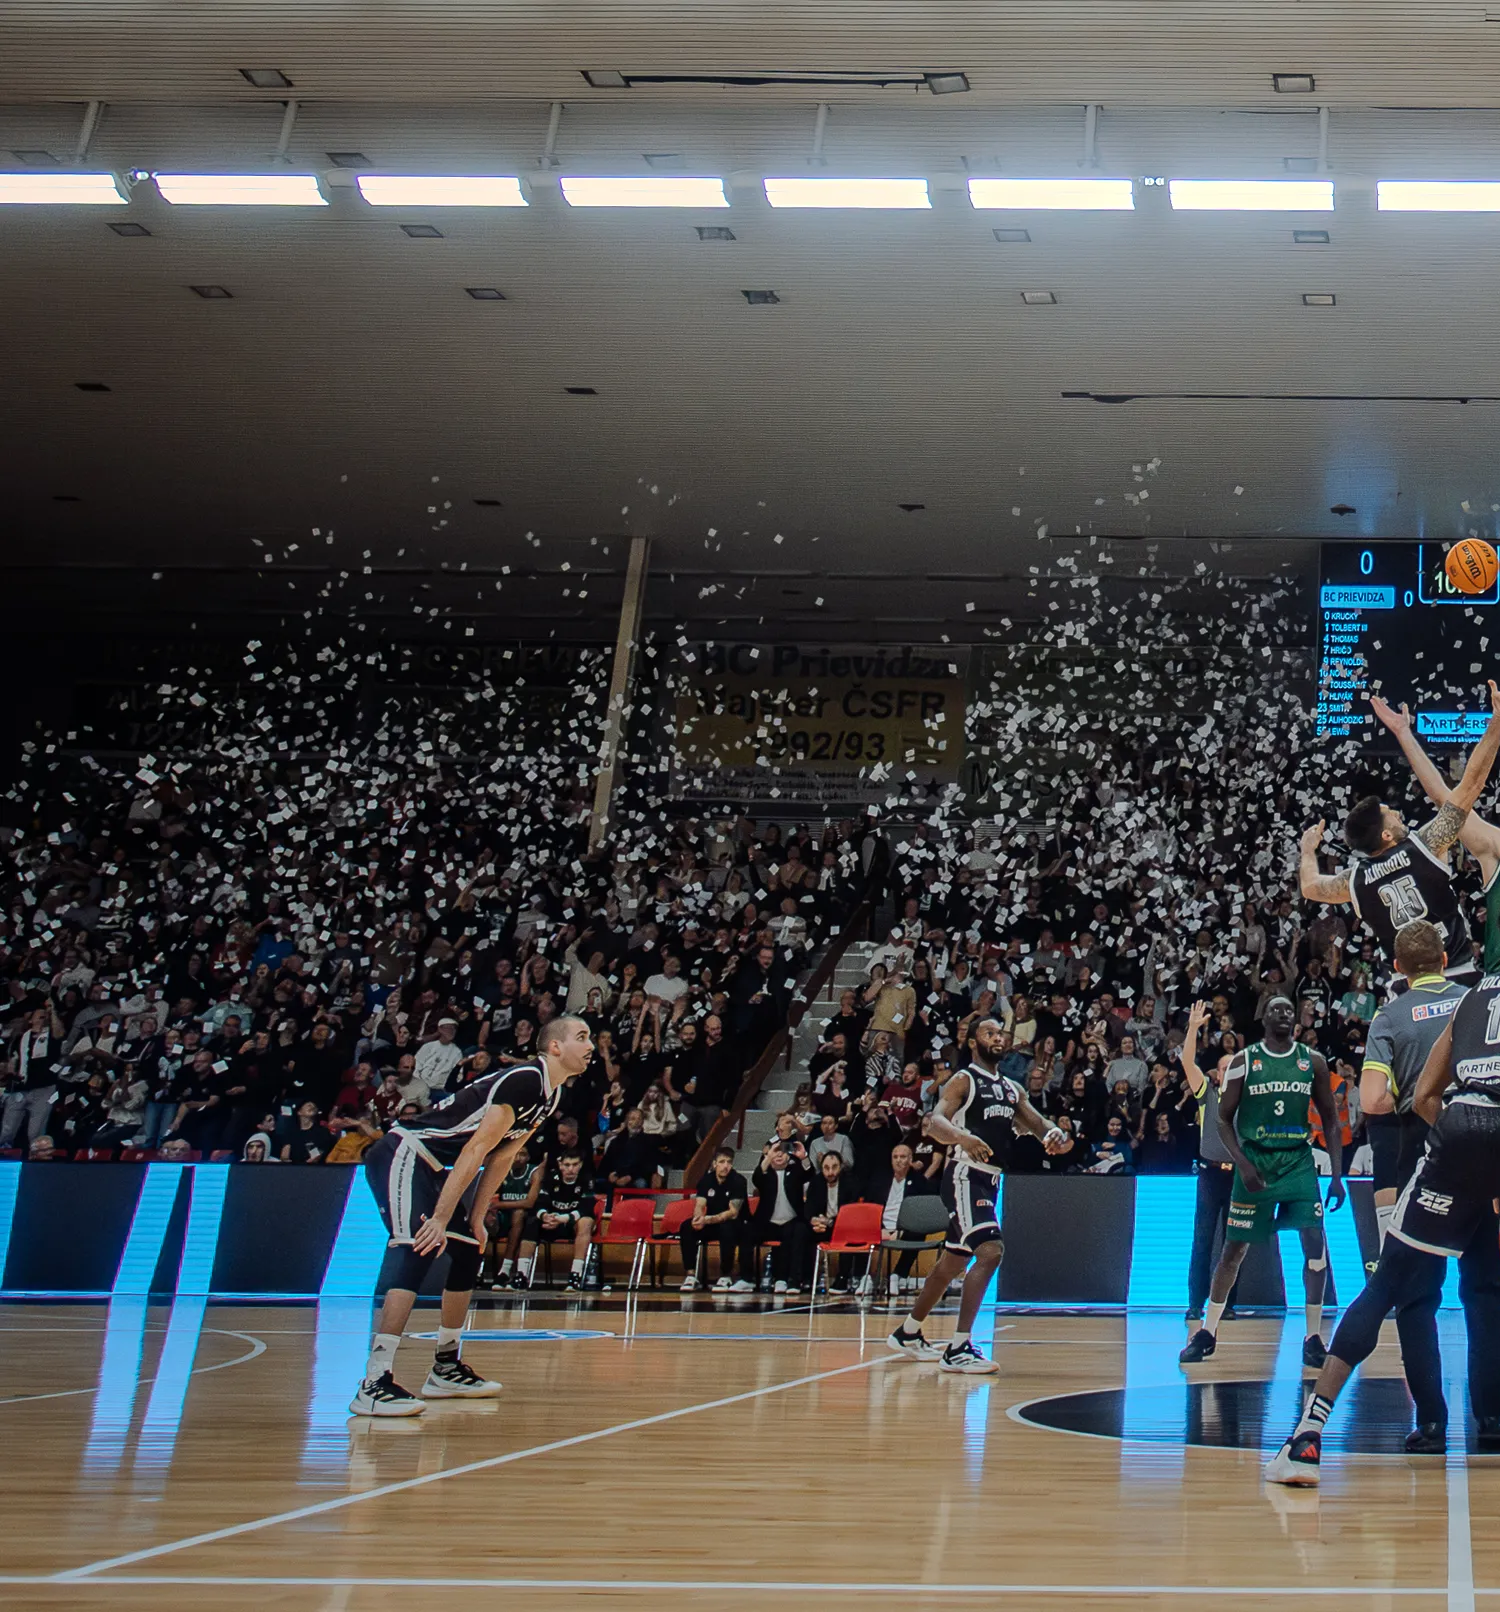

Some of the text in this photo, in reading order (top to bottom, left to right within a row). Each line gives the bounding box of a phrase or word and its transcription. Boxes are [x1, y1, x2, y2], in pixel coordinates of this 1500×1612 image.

[1360, 551, 1373, 575] 0
[1324, 592, 1385, 602] BC PRIEVIDZA
[1404, 590, 1413, 607] 0
[1324, 611, 1330, 620] 0
[1323, 634, 1329, 643] 4
[1323, 645, 1329, 654] 7
[842, 683, 946, 719] ČSFR
[1317, 703, 1327, 712] 23
[1317, 715, 1327, 724] 25
[754, 730, 885, 761] 1992/93
[1364, 850, 1411, 885] ALIHODZIC
[1377, 874, 1428, 930] 25
[1248, 1080, 1313, 1096] HANDLOVÁ
[1273, 1100, 1285, 1116] 3
[1313, 1201, 1323, 1217] 3
